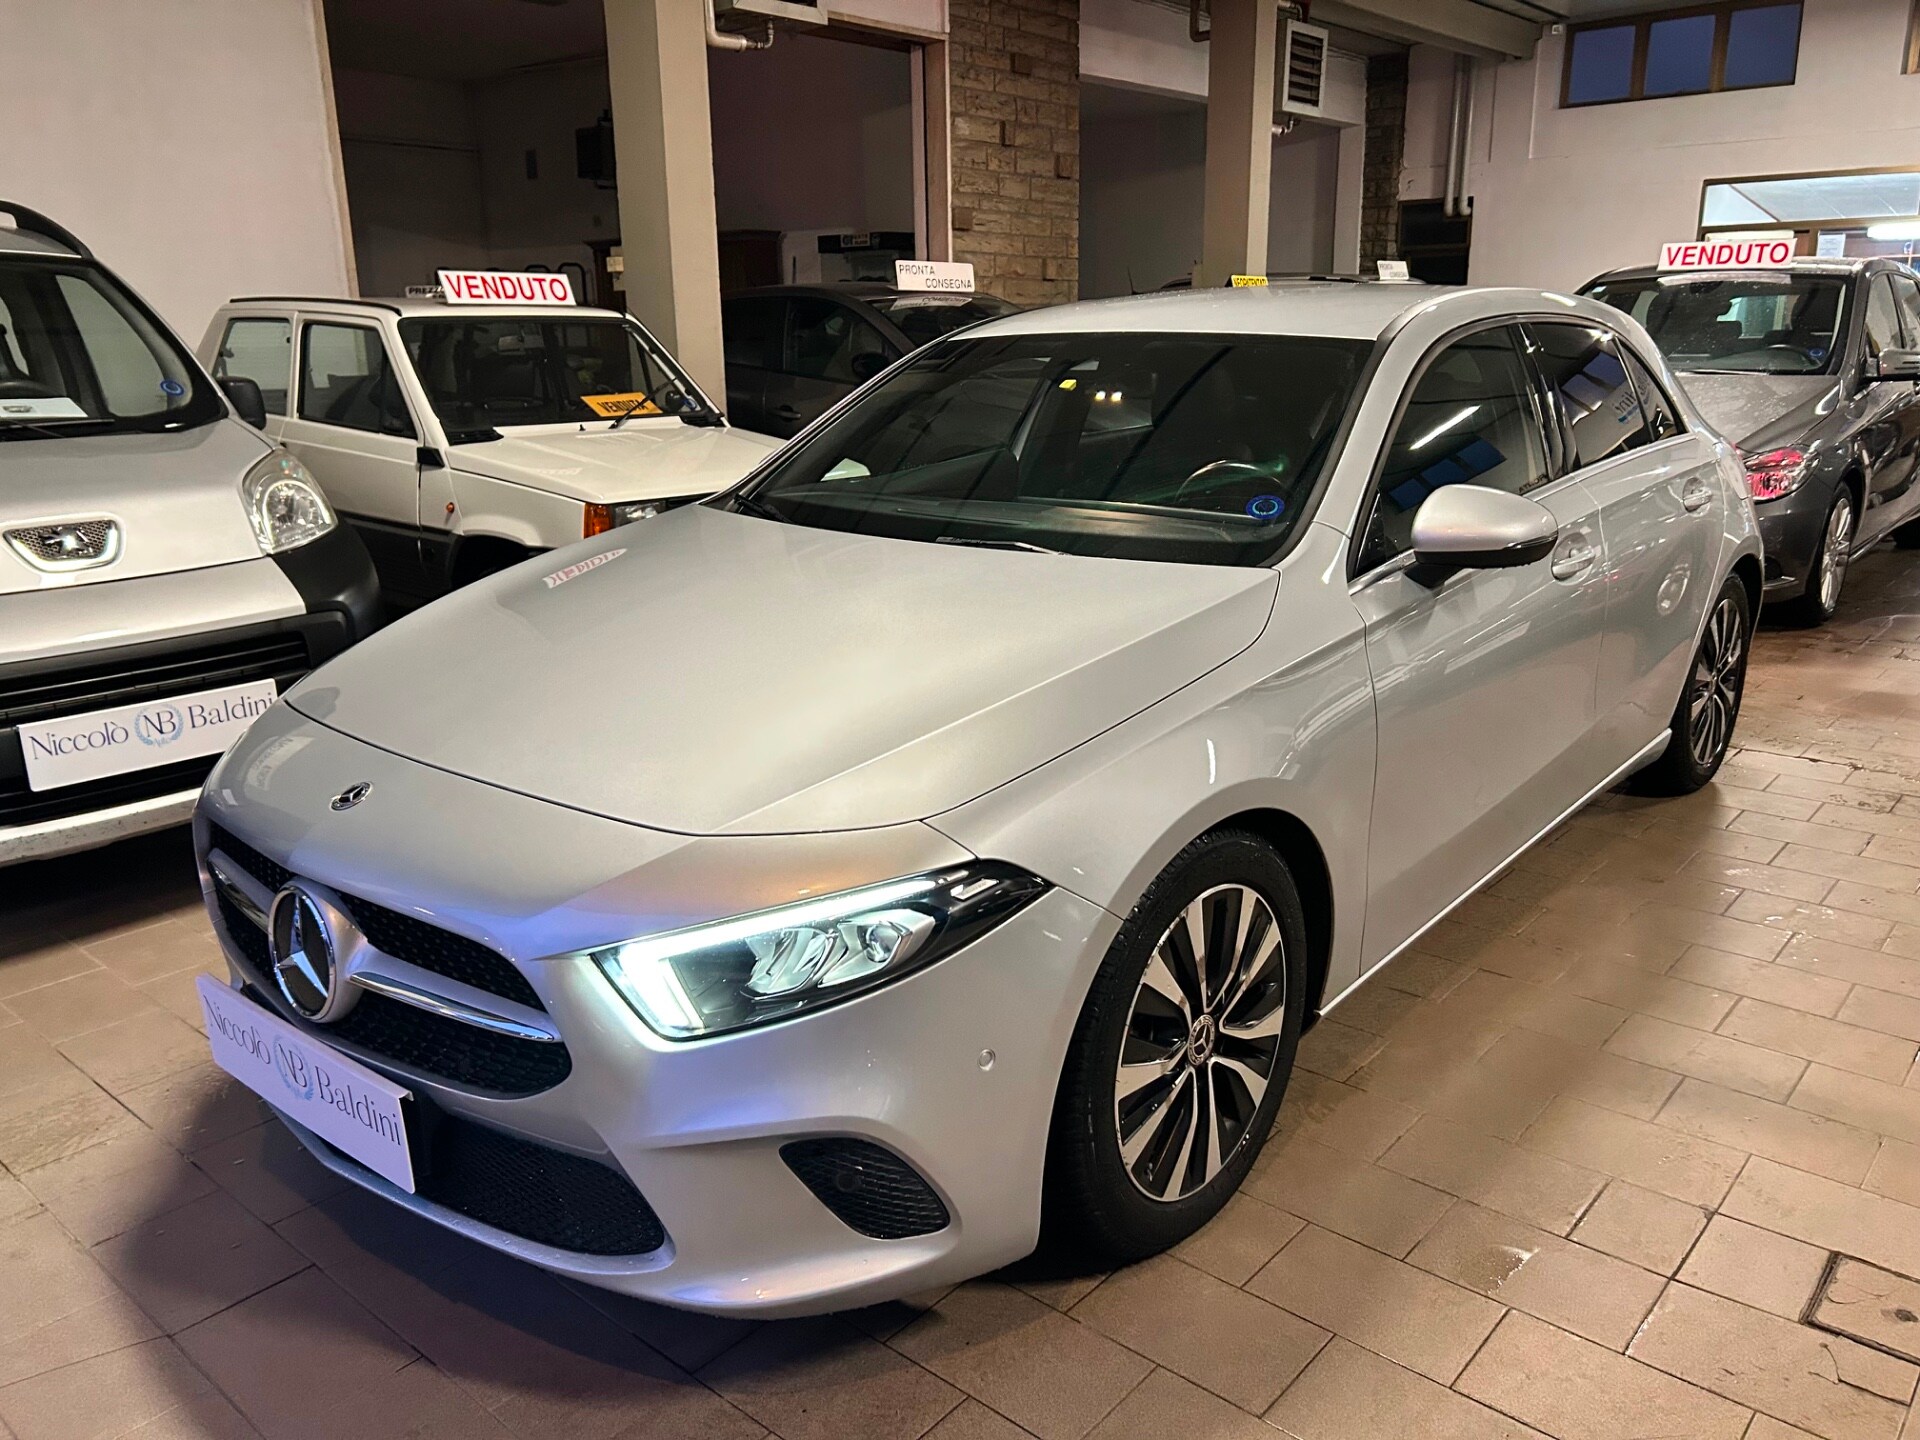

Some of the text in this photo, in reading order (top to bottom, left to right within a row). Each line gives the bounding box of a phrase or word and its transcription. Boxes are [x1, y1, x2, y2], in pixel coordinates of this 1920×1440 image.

[1666, 242, 1790, 266] VENDUTO
[898, 264, 935, 275] PRONTA
[444, 274, 568, 301] VENDUTO
[925, 278, 973, 289] CONSEGNA
[28, 721, 130, 761] Niccolò
[143, 709, 177, 738] NB
[203, 994, 401, 1146] Niccolò NB Baldini
